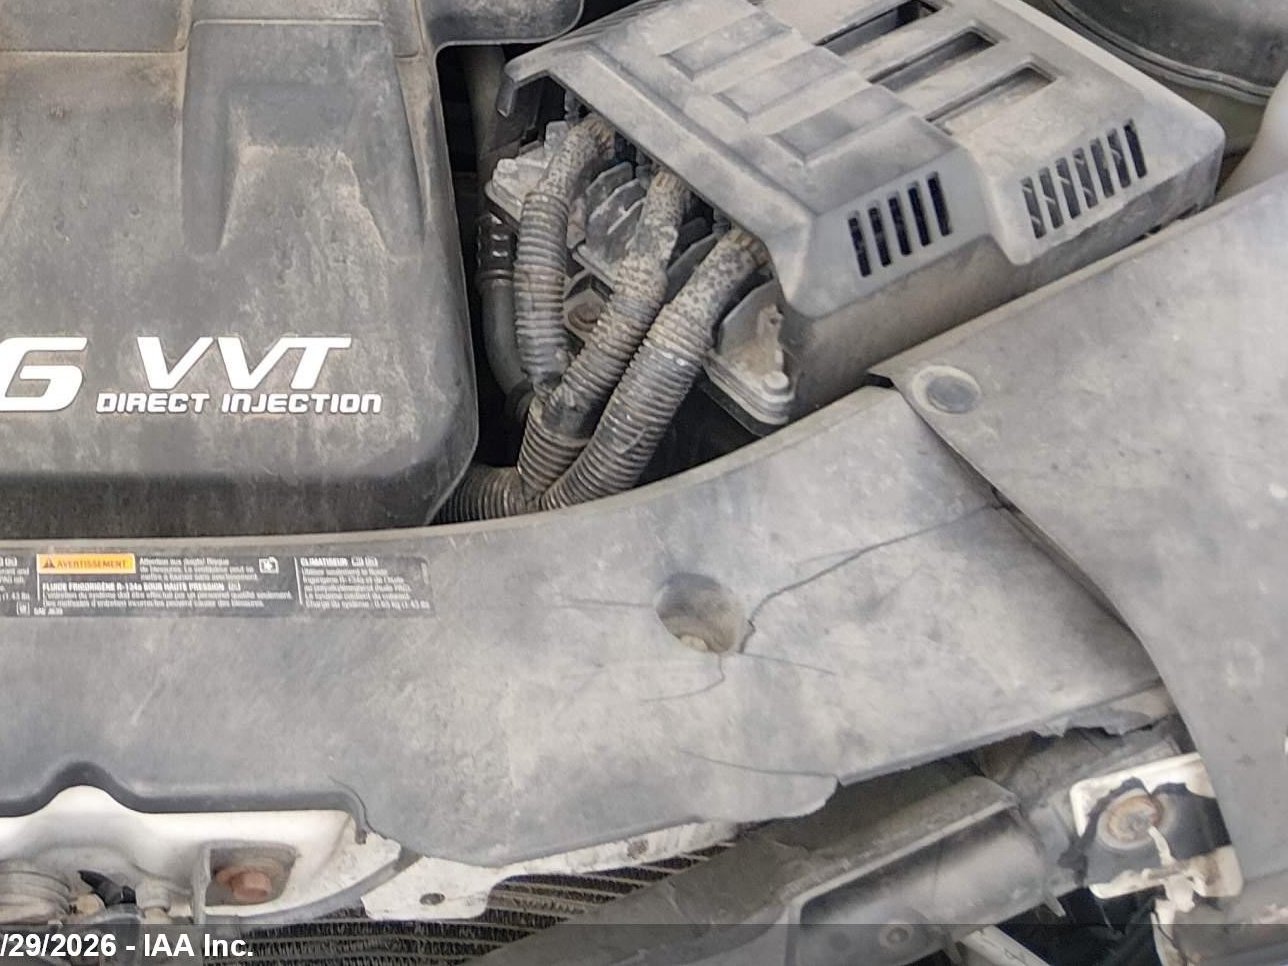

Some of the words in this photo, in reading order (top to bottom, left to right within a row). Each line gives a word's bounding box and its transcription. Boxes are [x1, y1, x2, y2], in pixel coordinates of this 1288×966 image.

[136, 336, 352, 390] VVT
[95, 392, 210, 414] DIRECT
[221, 392, 383, 414] INJECTION
[56, 560, 127, 570] AVERTISSEMENT
